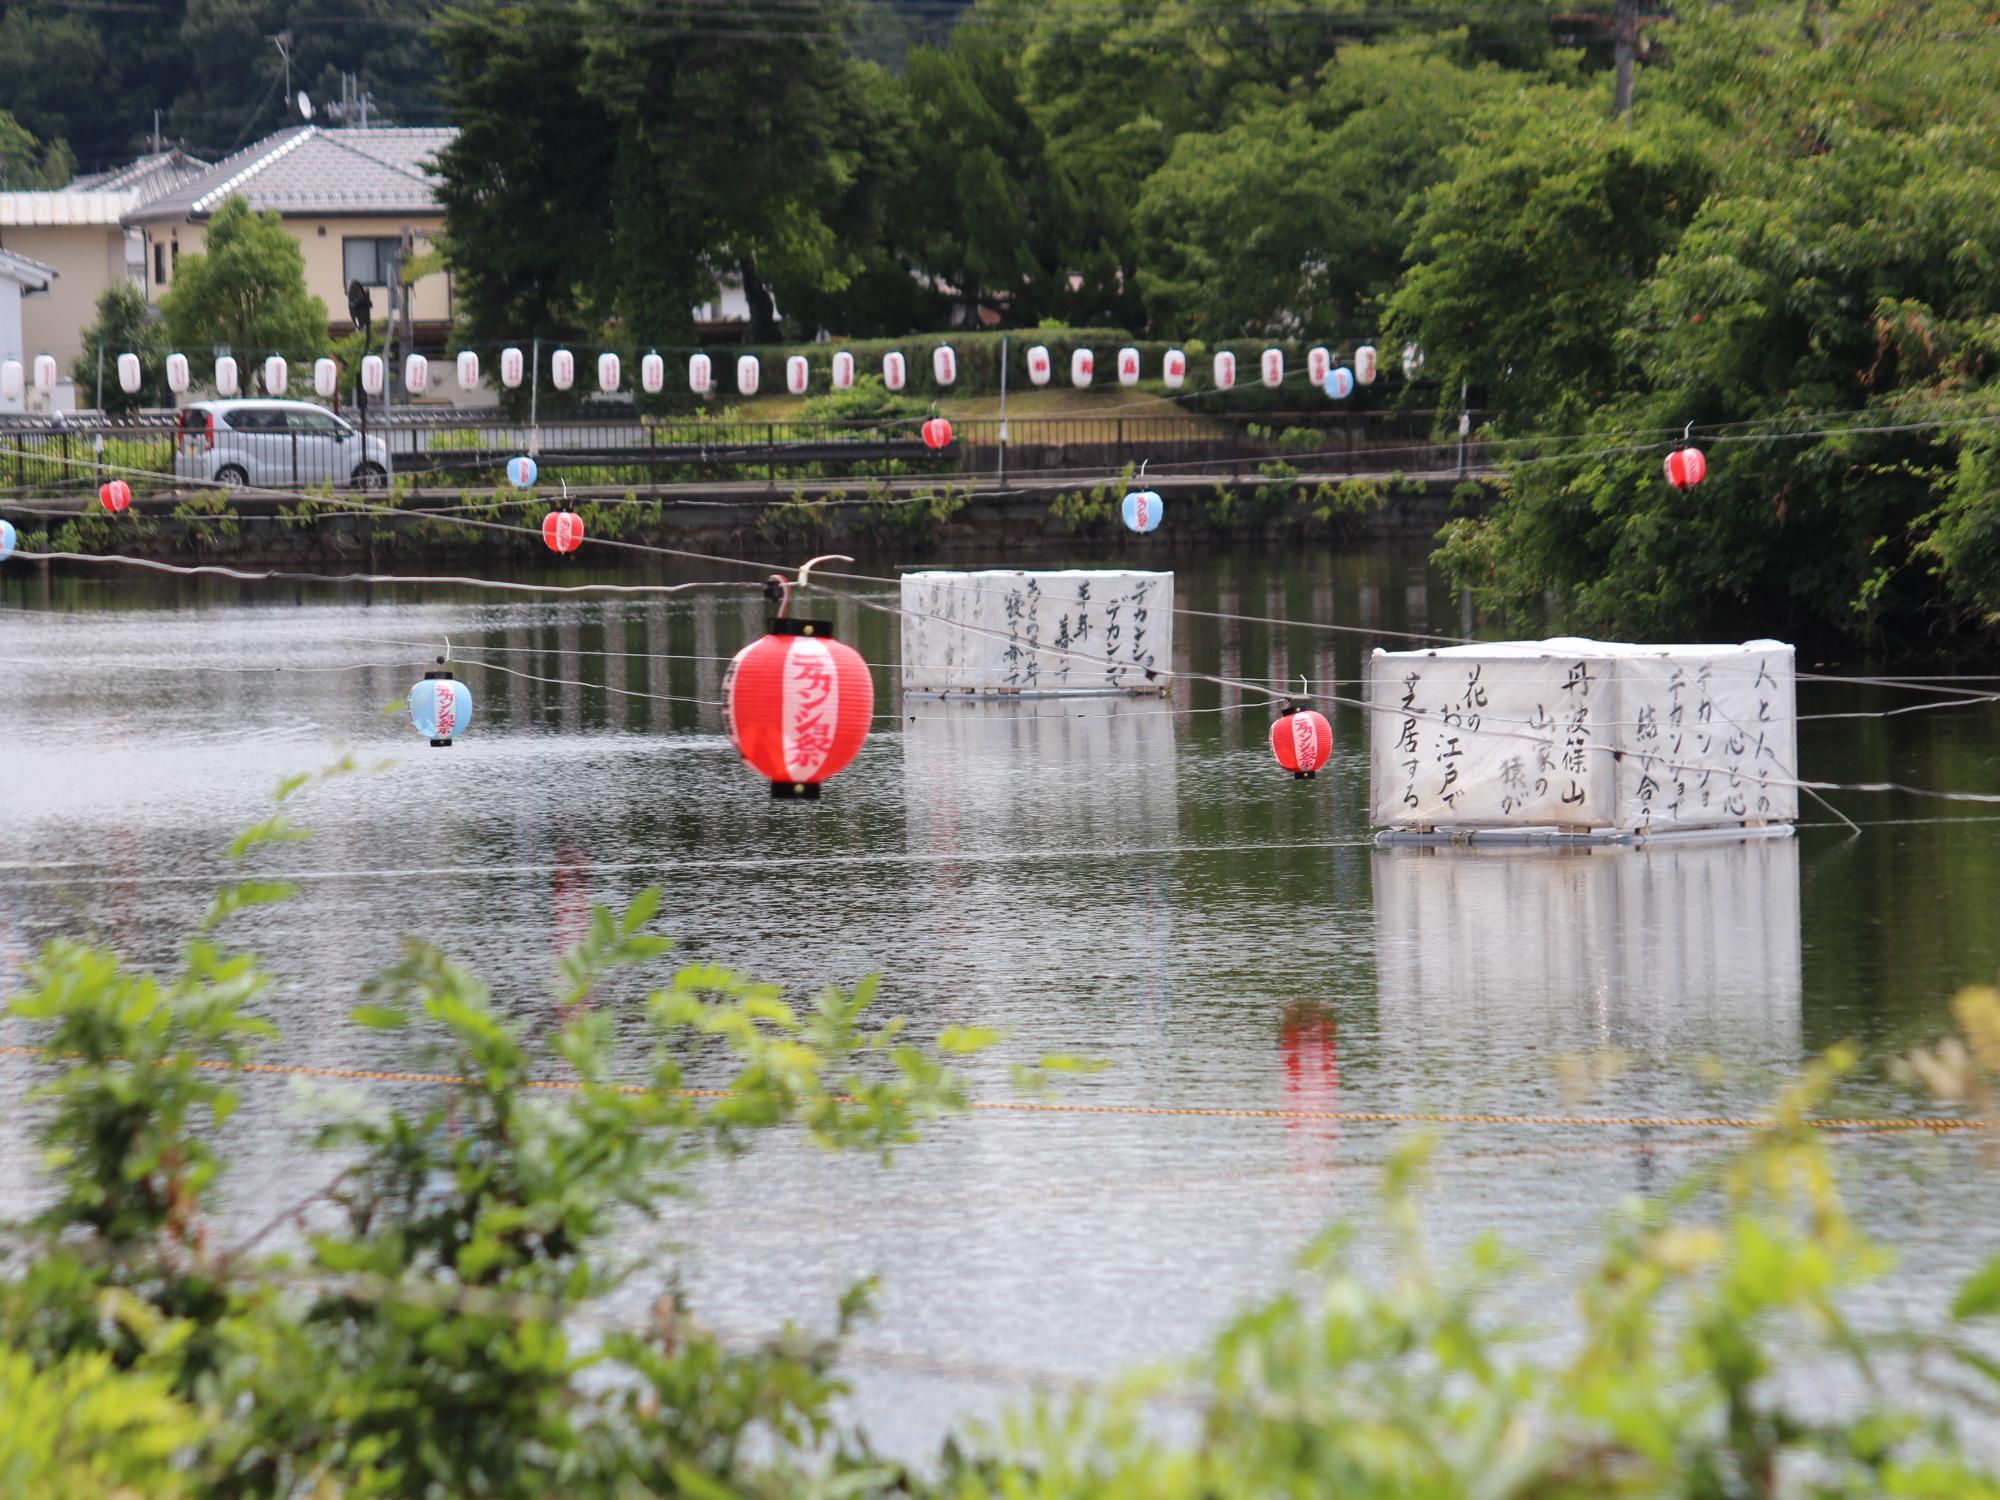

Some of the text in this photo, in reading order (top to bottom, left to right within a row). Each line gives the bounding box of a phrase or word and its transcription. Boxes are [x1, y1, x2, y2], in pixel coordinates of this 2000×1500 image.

[1130, 580, 1157, 668] デカンショ
[1394, 671, 1428, 809] 芝居する
[1463, 663, 1489, 733] 花の
[1561, 660, 1597, 806] 丹波篠山
[1754, 658, 1778, 813] 人と人との
[1435, 703, 1465, 810] お江戸で
[1529, 702, 1556, 798] 山家の
[1724, 731, 1746, 816] 心と心
